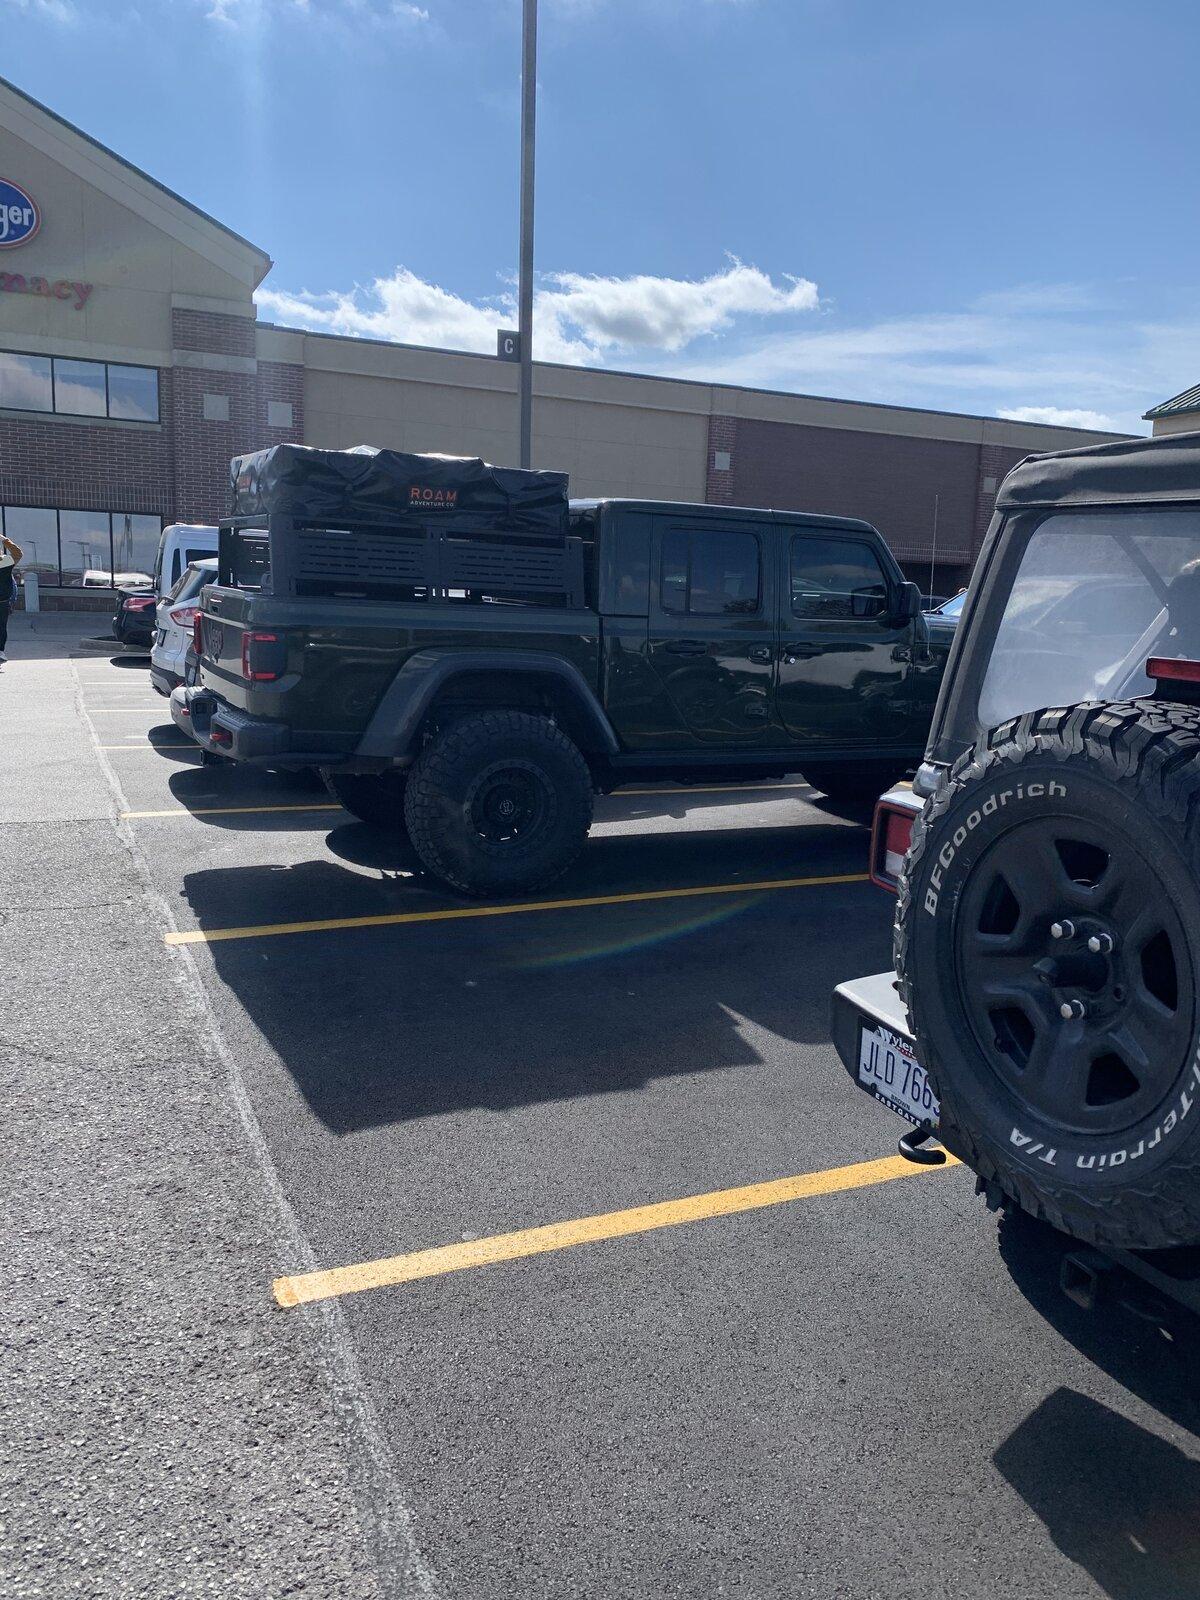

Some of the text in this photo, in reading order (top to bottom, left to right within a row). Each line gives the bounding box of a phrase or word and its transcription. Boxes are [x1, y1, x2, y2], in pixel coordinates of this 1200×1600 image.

[504, 338, 513, 354] C
[410, 487, 457, 501] ROAM
[924, 780, 1067, 916] BFGoodrich
[877, 1025, 914, 1054] Wyler
[863, 1041, 895, 1085] JLD
[875, 1092, 921, 1128] EASTGATE
[1009, 1127, 1057, 1166] T/A
